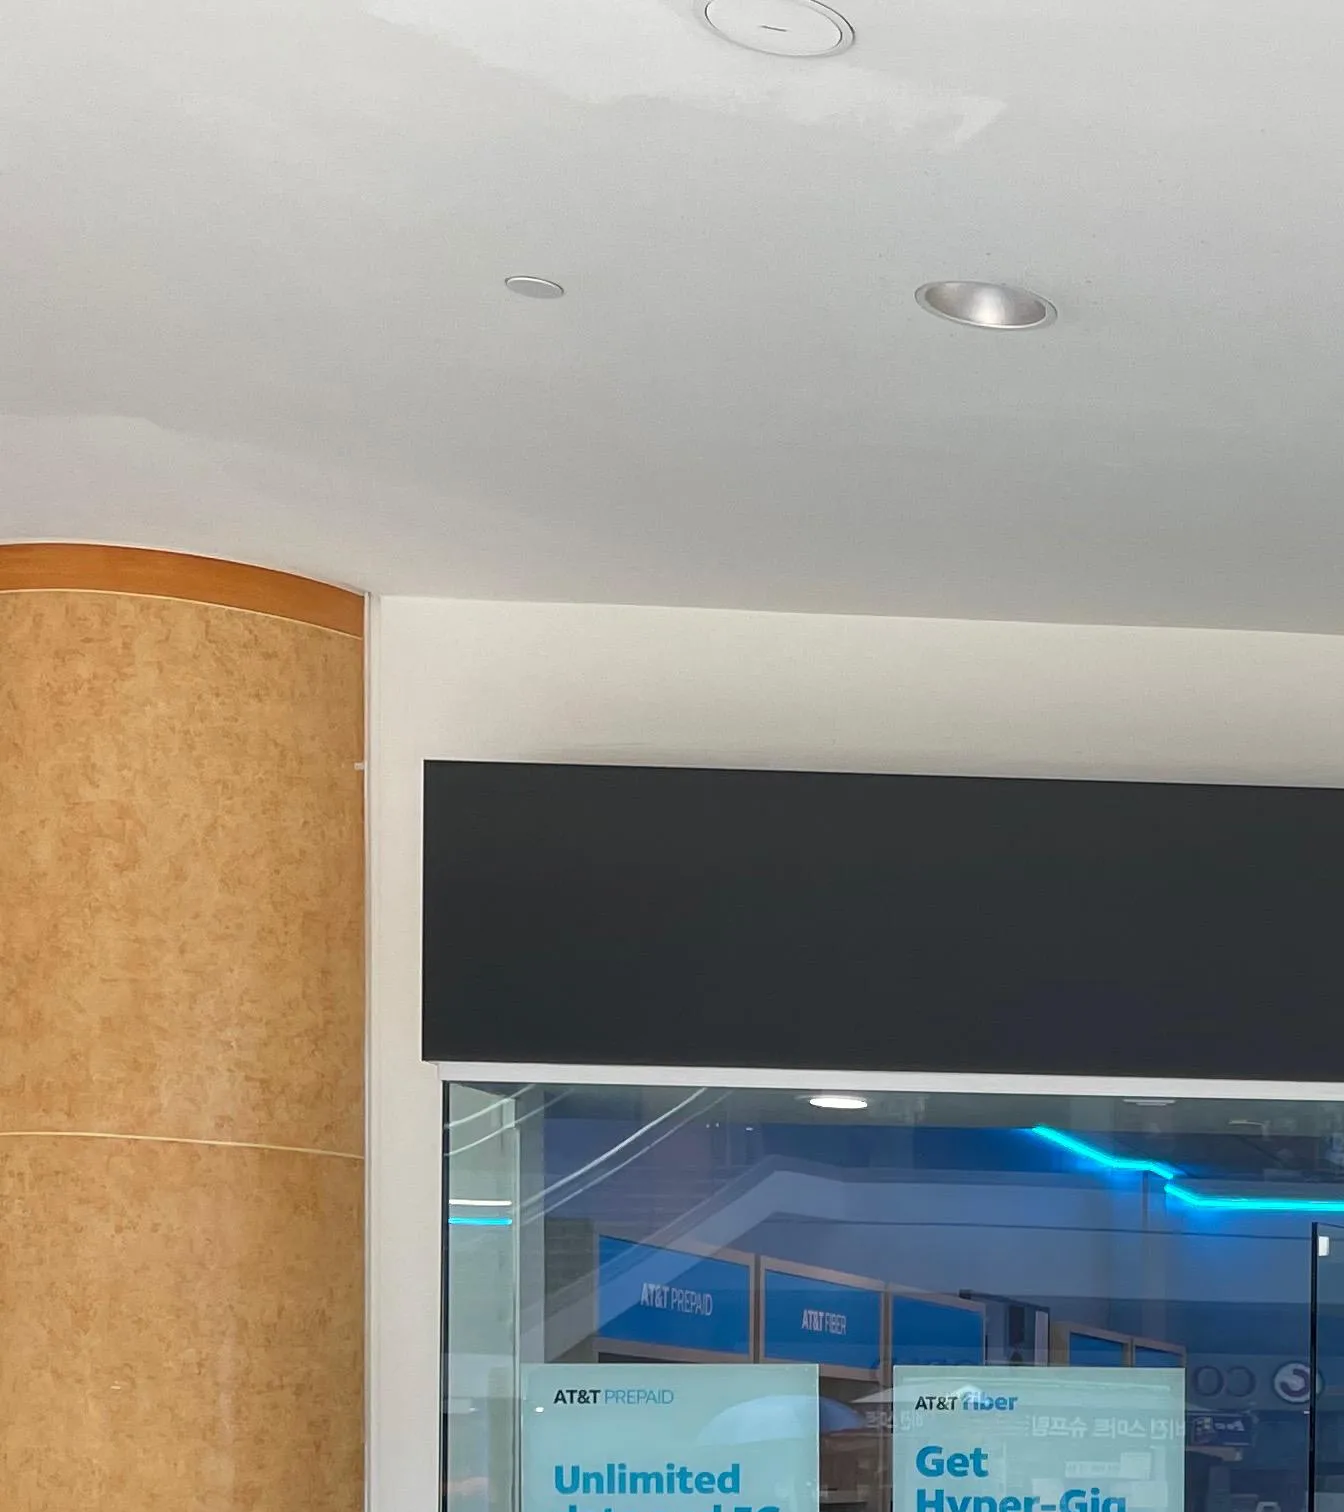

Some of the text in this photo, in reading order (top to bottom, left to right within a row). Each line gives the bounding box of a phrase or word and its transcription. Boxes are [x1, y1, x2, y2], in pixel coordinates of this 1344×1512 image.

[641, 1283, 713, 1317] AT&T PREPAID
[802, 1309, 847, 1336] AT&T FIBER
[553, 1389, 675, 1405] AT&T PREPAID
[915, 1391, 1018, 1411] AT&T fiber
[915, 1445, 989, 1478] Get
[554, 1463, 741, 1495] Unlimited
